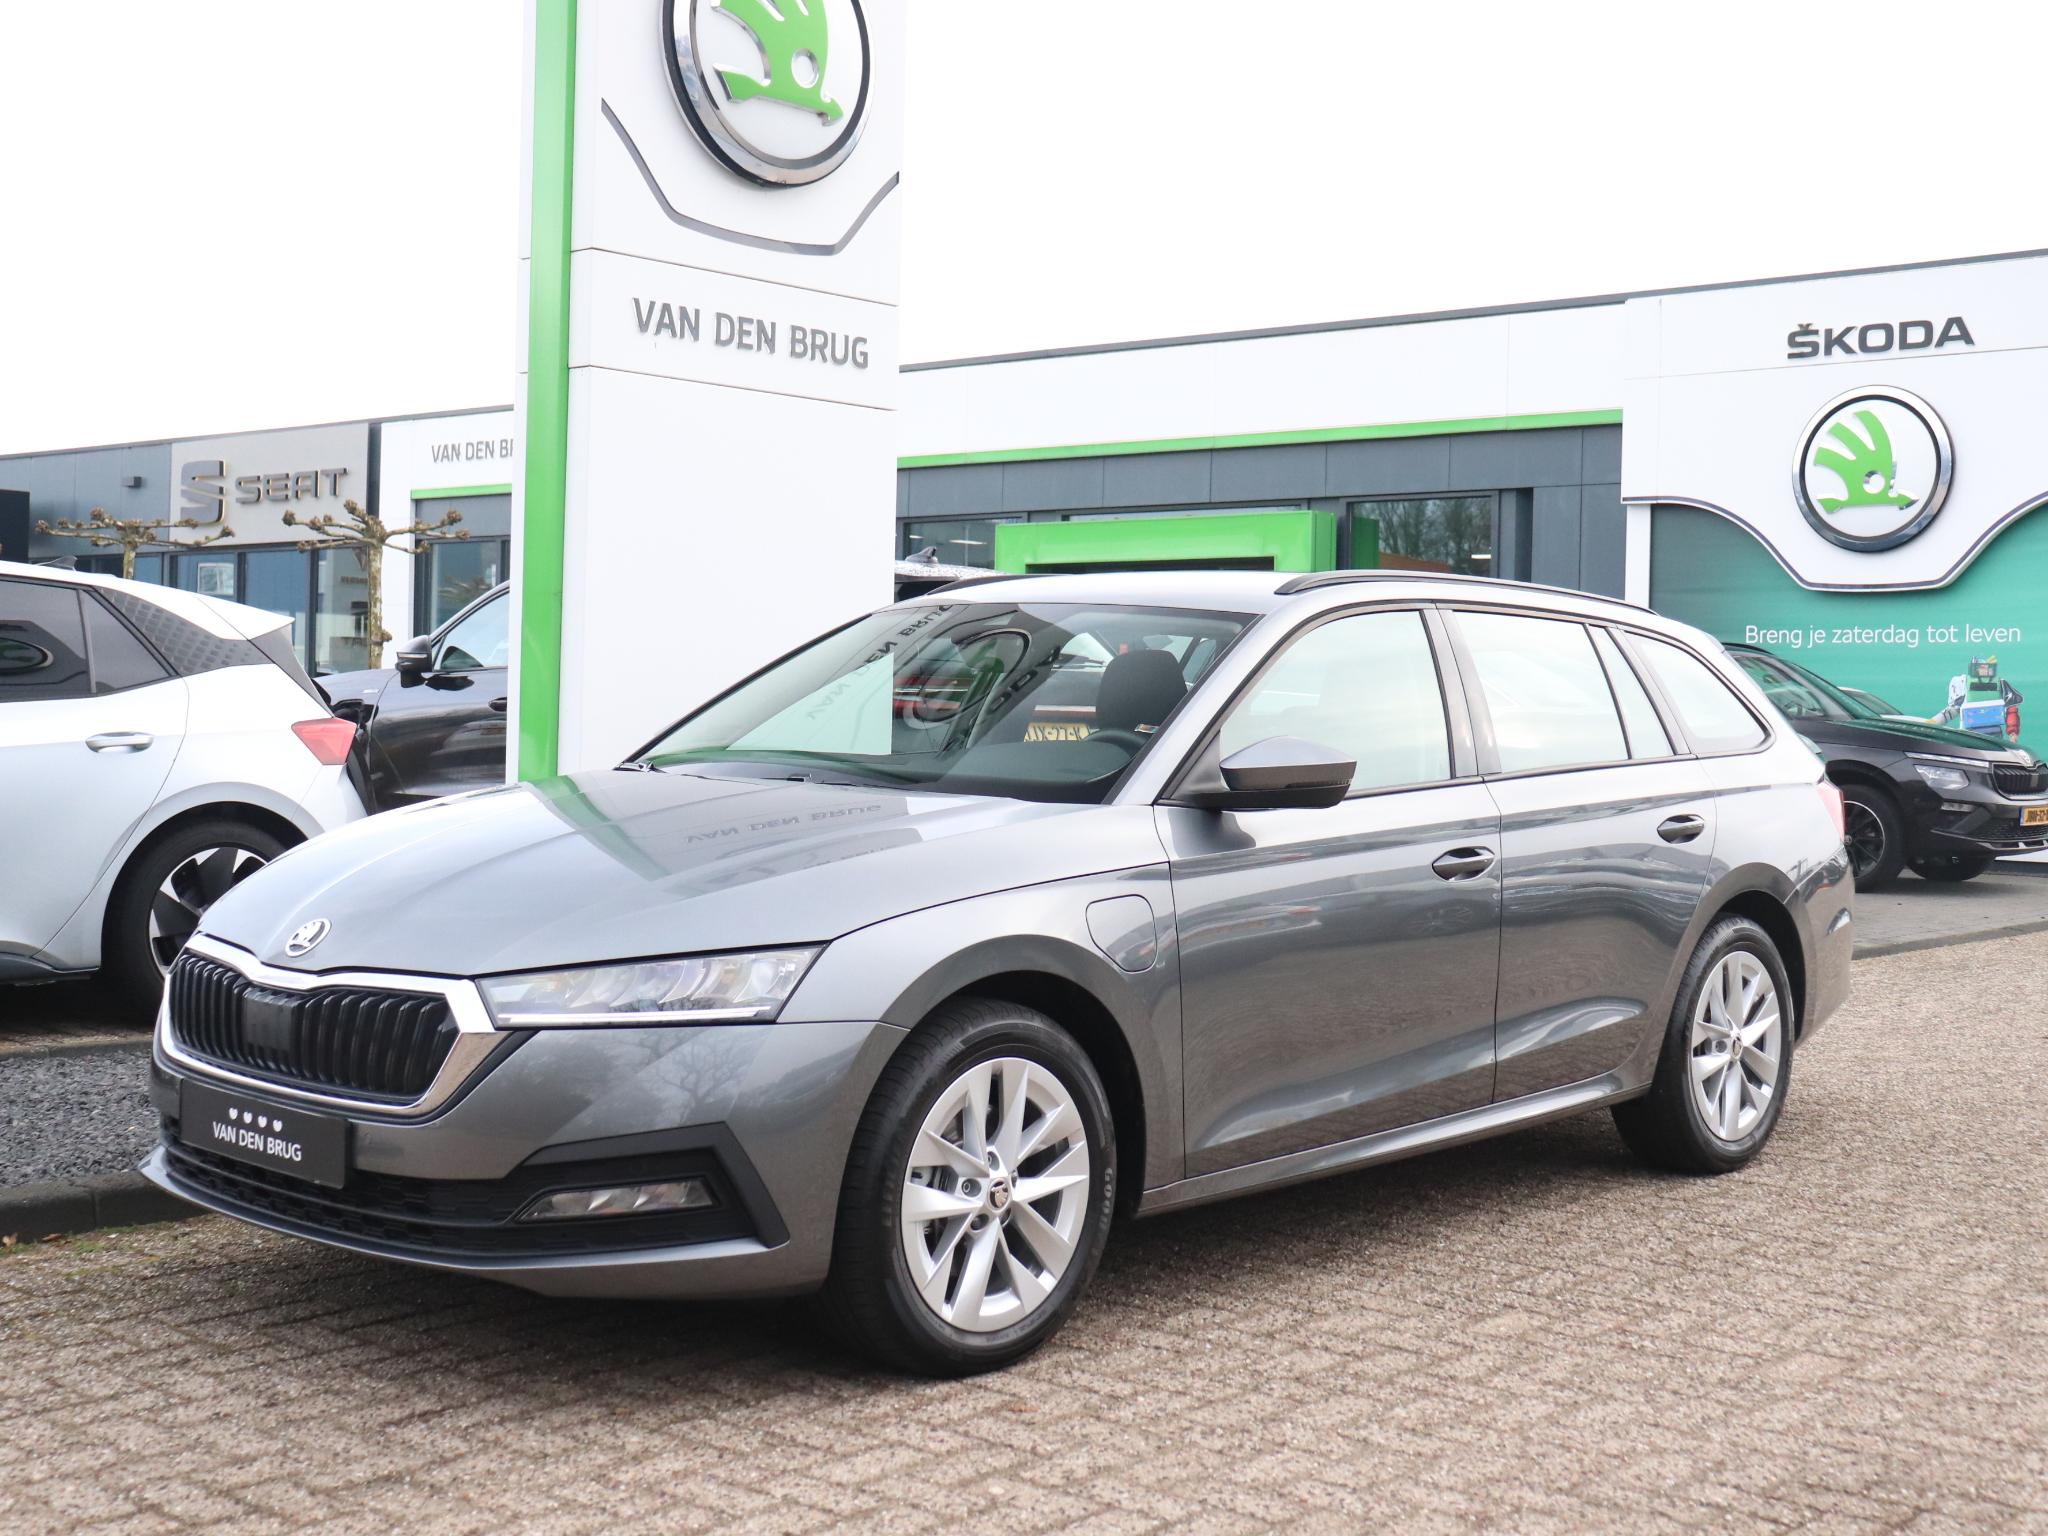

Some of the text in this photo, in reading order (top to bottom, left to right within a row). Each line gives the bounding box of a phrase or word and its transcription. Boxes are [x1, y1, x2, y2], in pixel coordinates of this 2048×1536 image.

[633, 297, 869, 369] VAN DEN BRUG
[1786, 316, 1975, 360] ŠKODA
[431, 443, 461, 463] VAN
[465, 440, 495, 461] DEN
[235, 468, 349, 504] SEAT
[1745, 624, 2021, 648] Breng je zaterdag tot leven
[213, 1121, 302, 1162] VAN DEN BRUG
